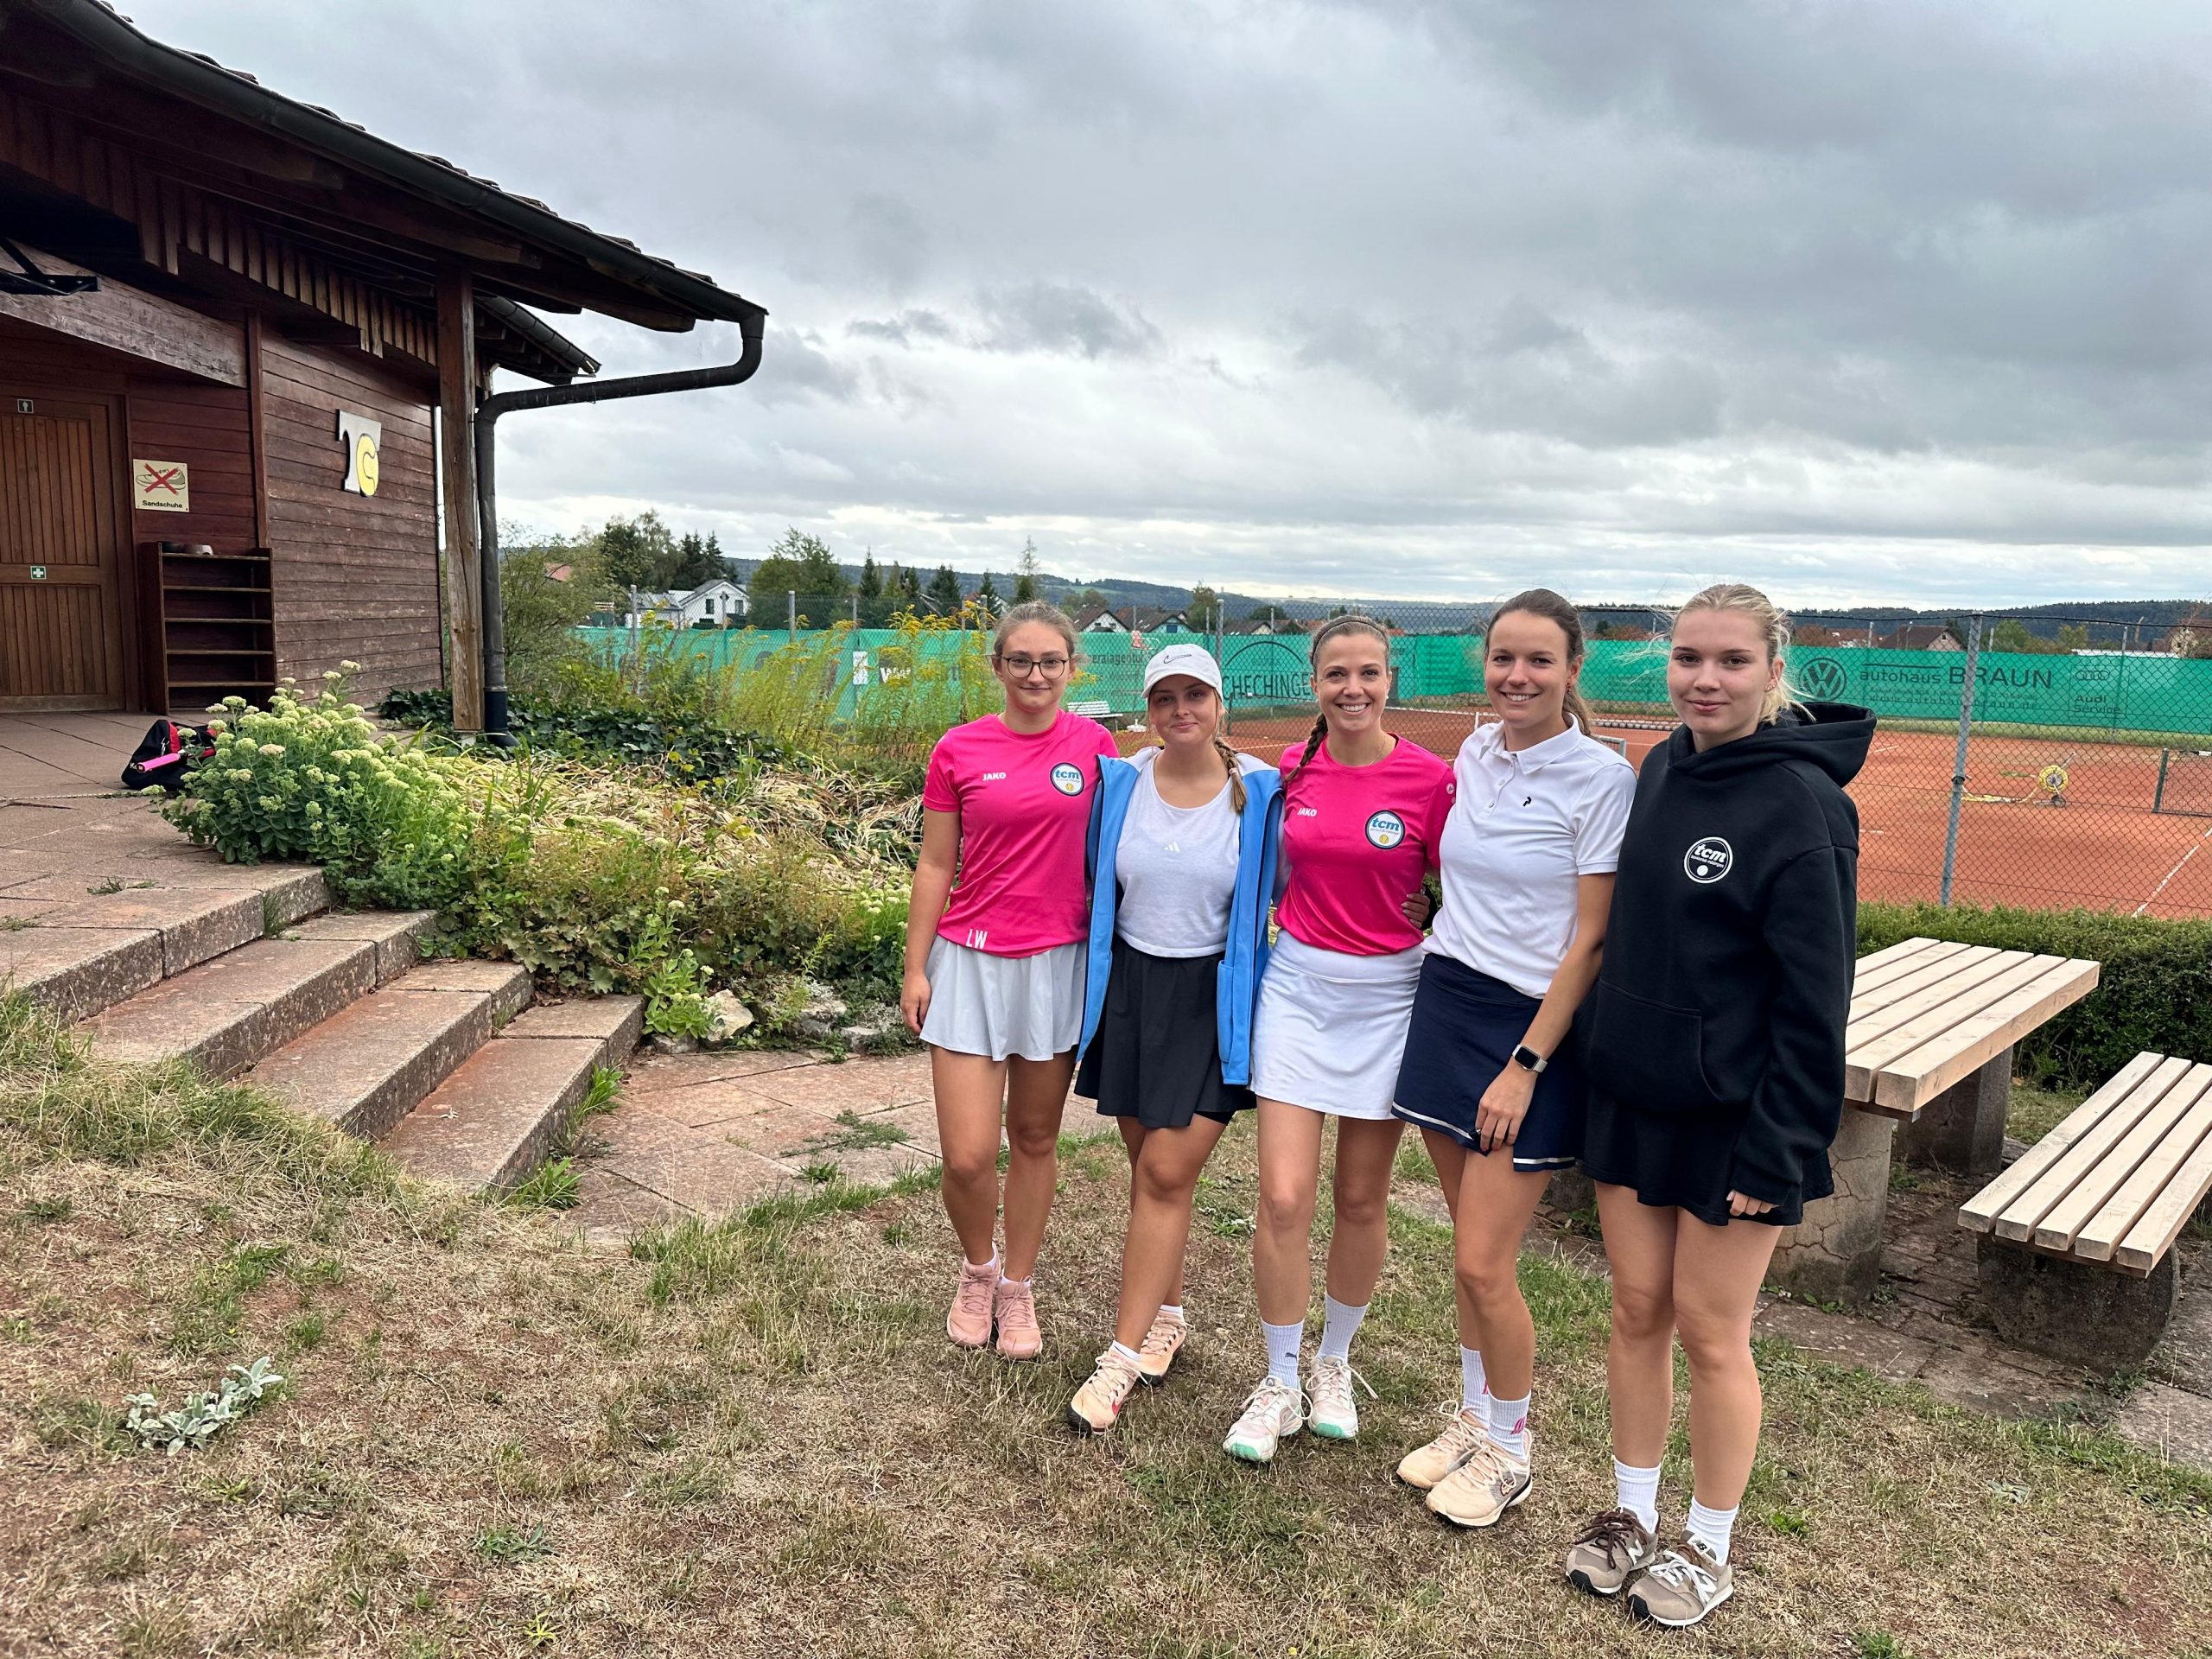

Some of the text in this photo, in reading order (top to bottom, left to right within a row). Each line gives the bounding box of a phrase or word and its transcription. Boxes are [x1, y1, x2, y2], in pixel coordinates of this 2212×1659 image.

[1859, 665, 2052, 689] autohaus BRAUN
[1222, 674, 1315, 701] CHECHINGE
[2075, 695, 2107, 703] Audi
[2075, 704, 2121, 714] Service
[982, 772, 1007, 781] JAKO
[1055, 769, 1079, 780] tcm
[1371, 817, 1400, 831] tcm
[1694, 843, 1726, 863] tcm
[966, 928, 988, 949] LW
